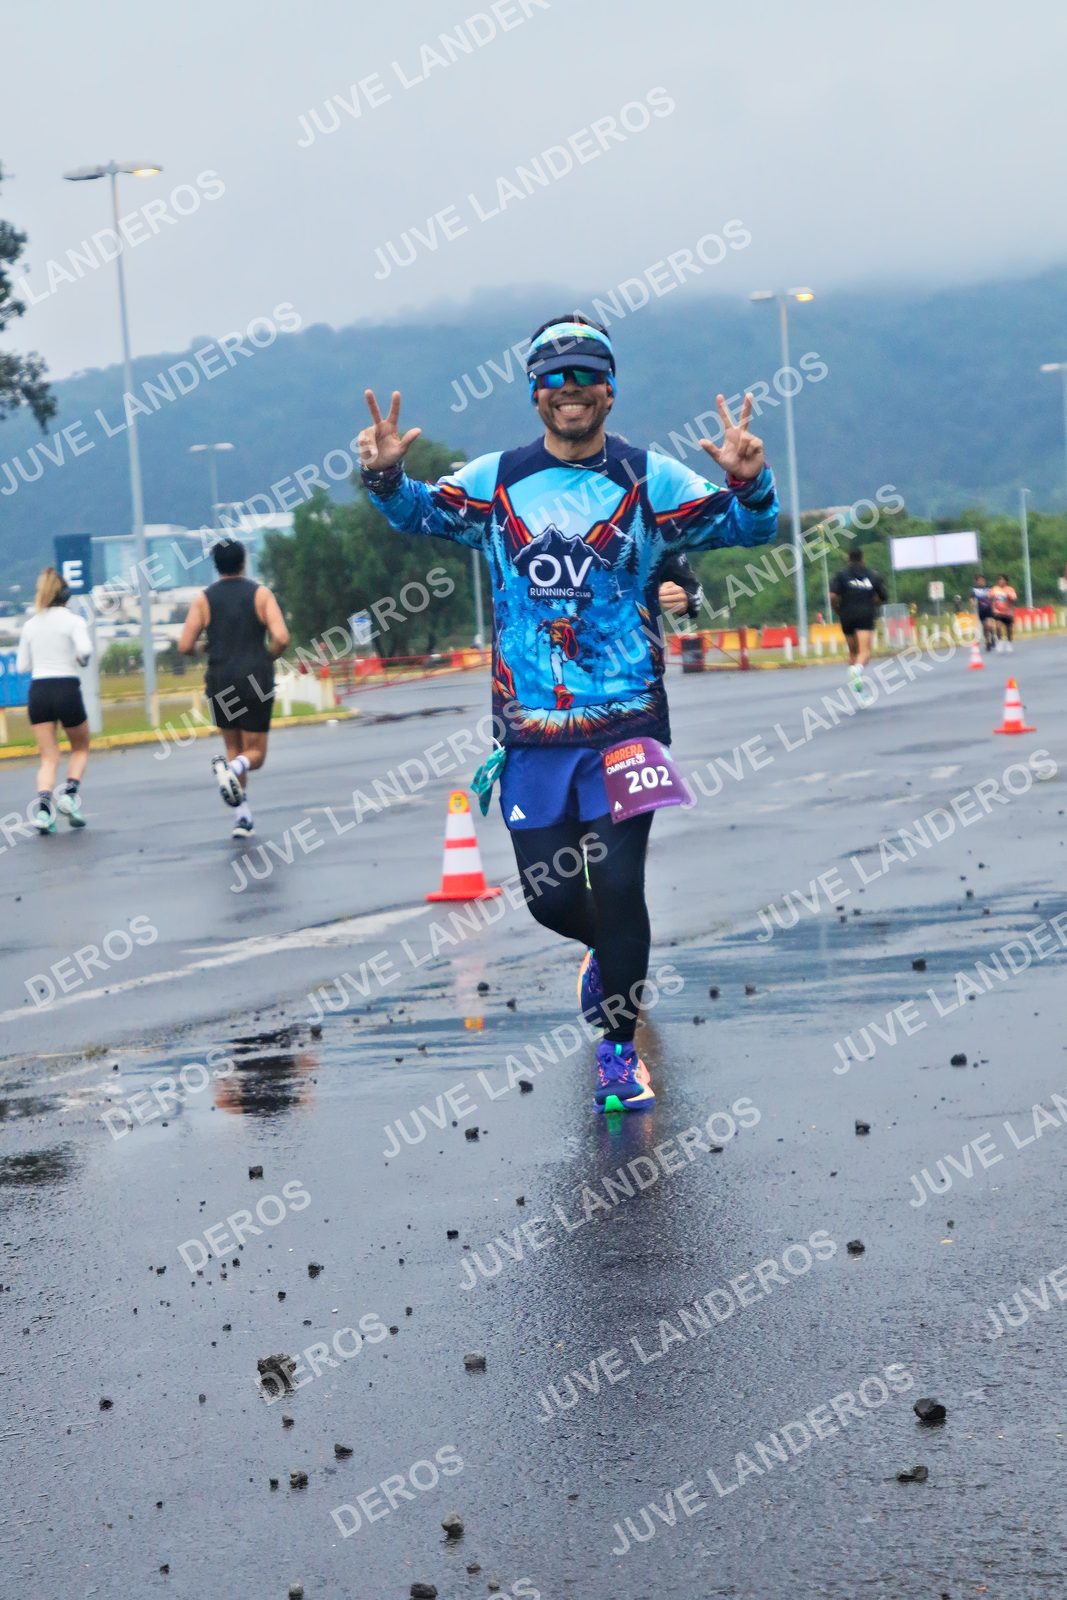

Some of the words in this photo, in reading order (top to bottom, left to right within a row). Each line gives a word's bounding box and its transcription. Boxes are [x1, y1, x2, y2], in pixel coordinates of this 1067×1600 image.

[62, 560, 84, 588] E
[528, 553, 593, 588] OV
[529, 587, 574, 597] RUNNING
[605, 743, 644, 767] CARRERA
[625, 765, 673, 794] 202
